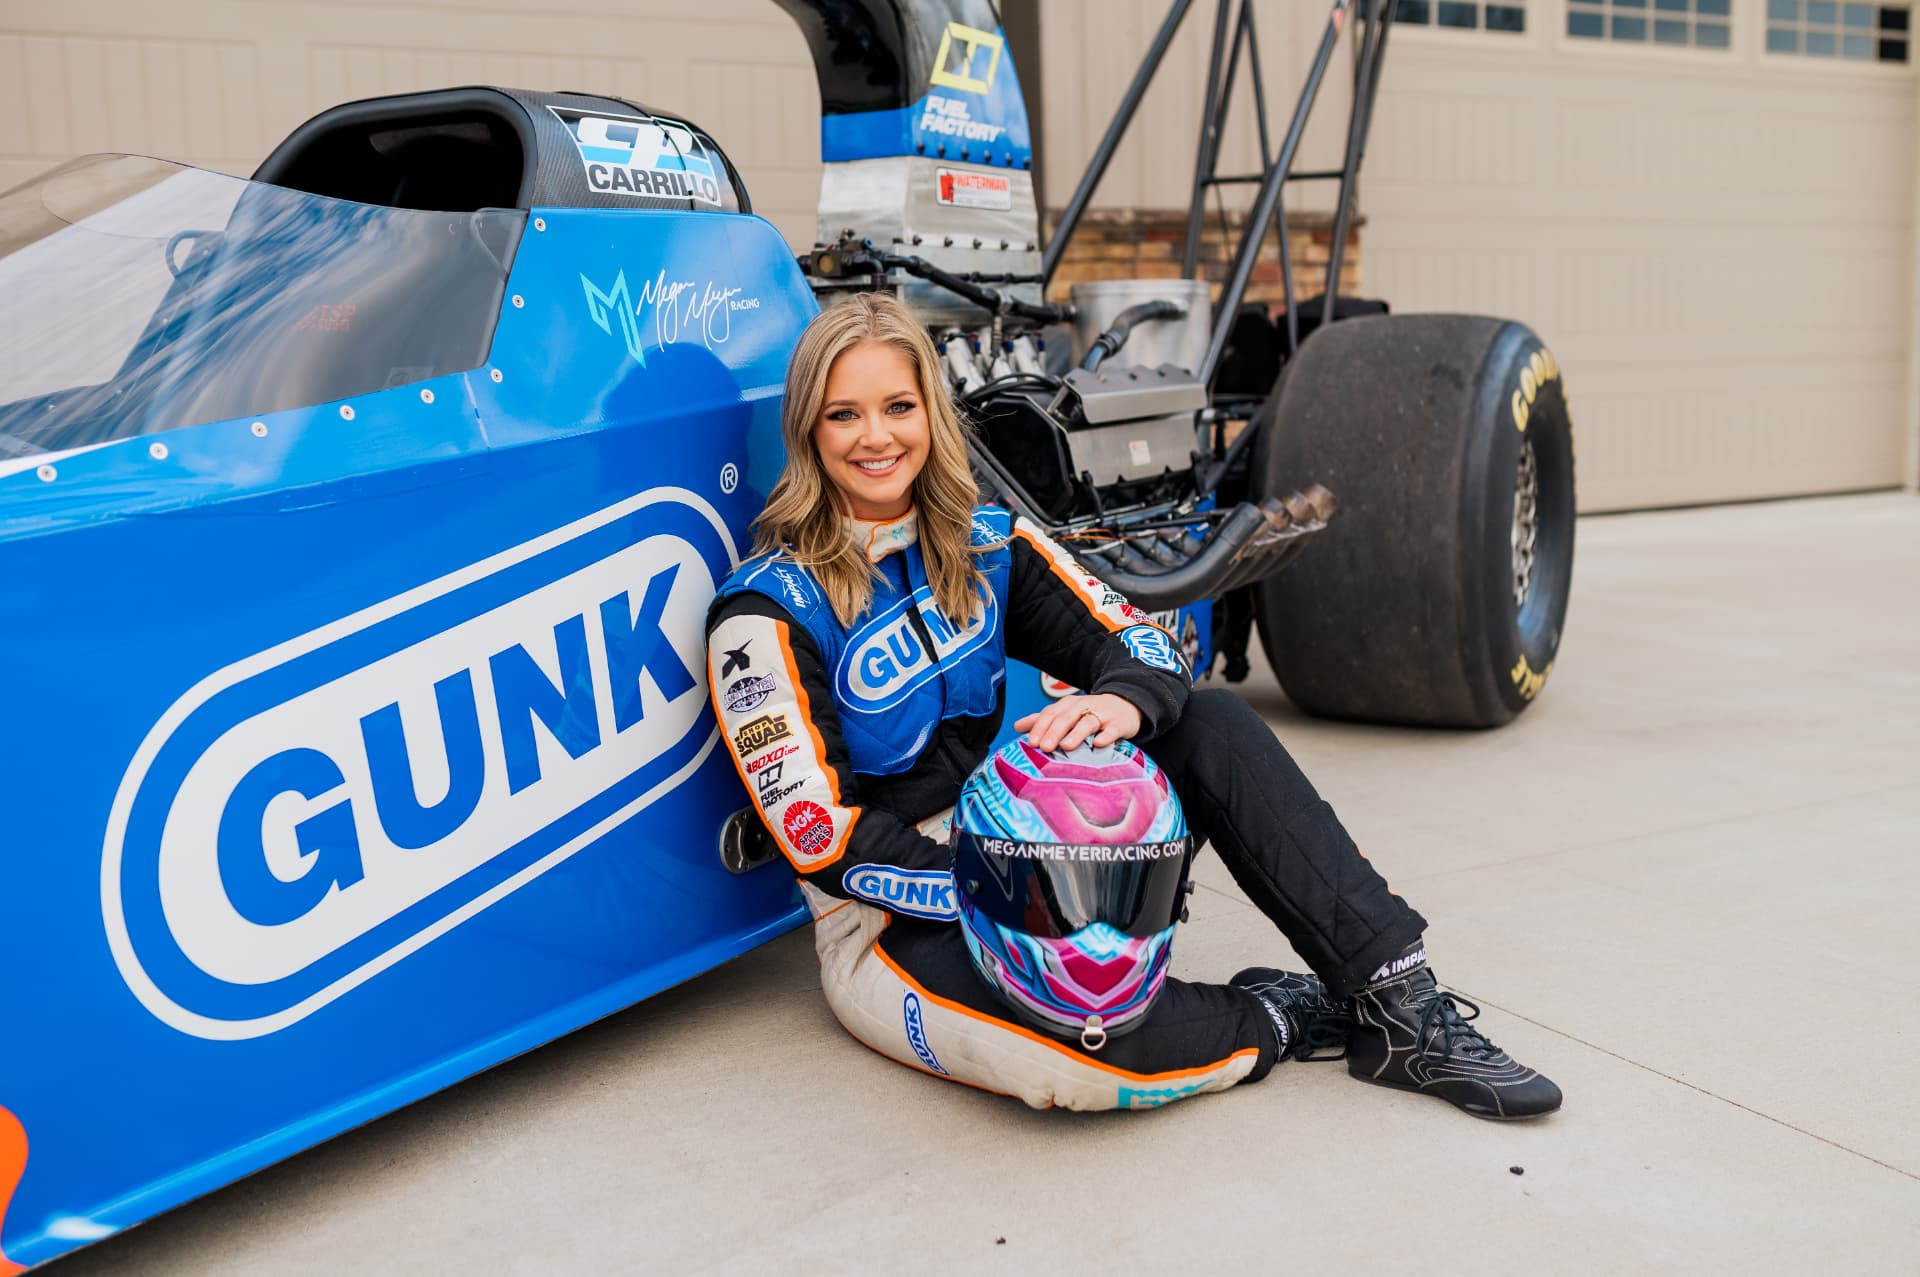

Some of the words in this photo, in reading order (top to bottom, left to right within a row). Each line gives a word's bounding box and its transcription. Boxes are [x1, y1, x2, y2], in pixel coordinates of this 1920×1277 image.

[925, 95, 970, 120] FUEL
[920, 112, 999, 142] FACTORY
[588, 164, 718, 201] CARRILLO
[730, 298, 760, 311] RACING
[860, 603, 979, 688] GUN
[737, 722, 788, 752] SQUAD
[743, 722, 767, 736] SHOP
[216, 563, 697, 926] GUNK
[752, 747, 785, 773] BOXO
[760, 787, 783, 802] FUEL
[763, 779, 805, 810] FACTORY
[787, 806, 816, 836] NGK
[800, 822, 824, 845] SPARK
[805, 829, 831, 851] PLUGS
[859, 875, 953, 909] GUNK
